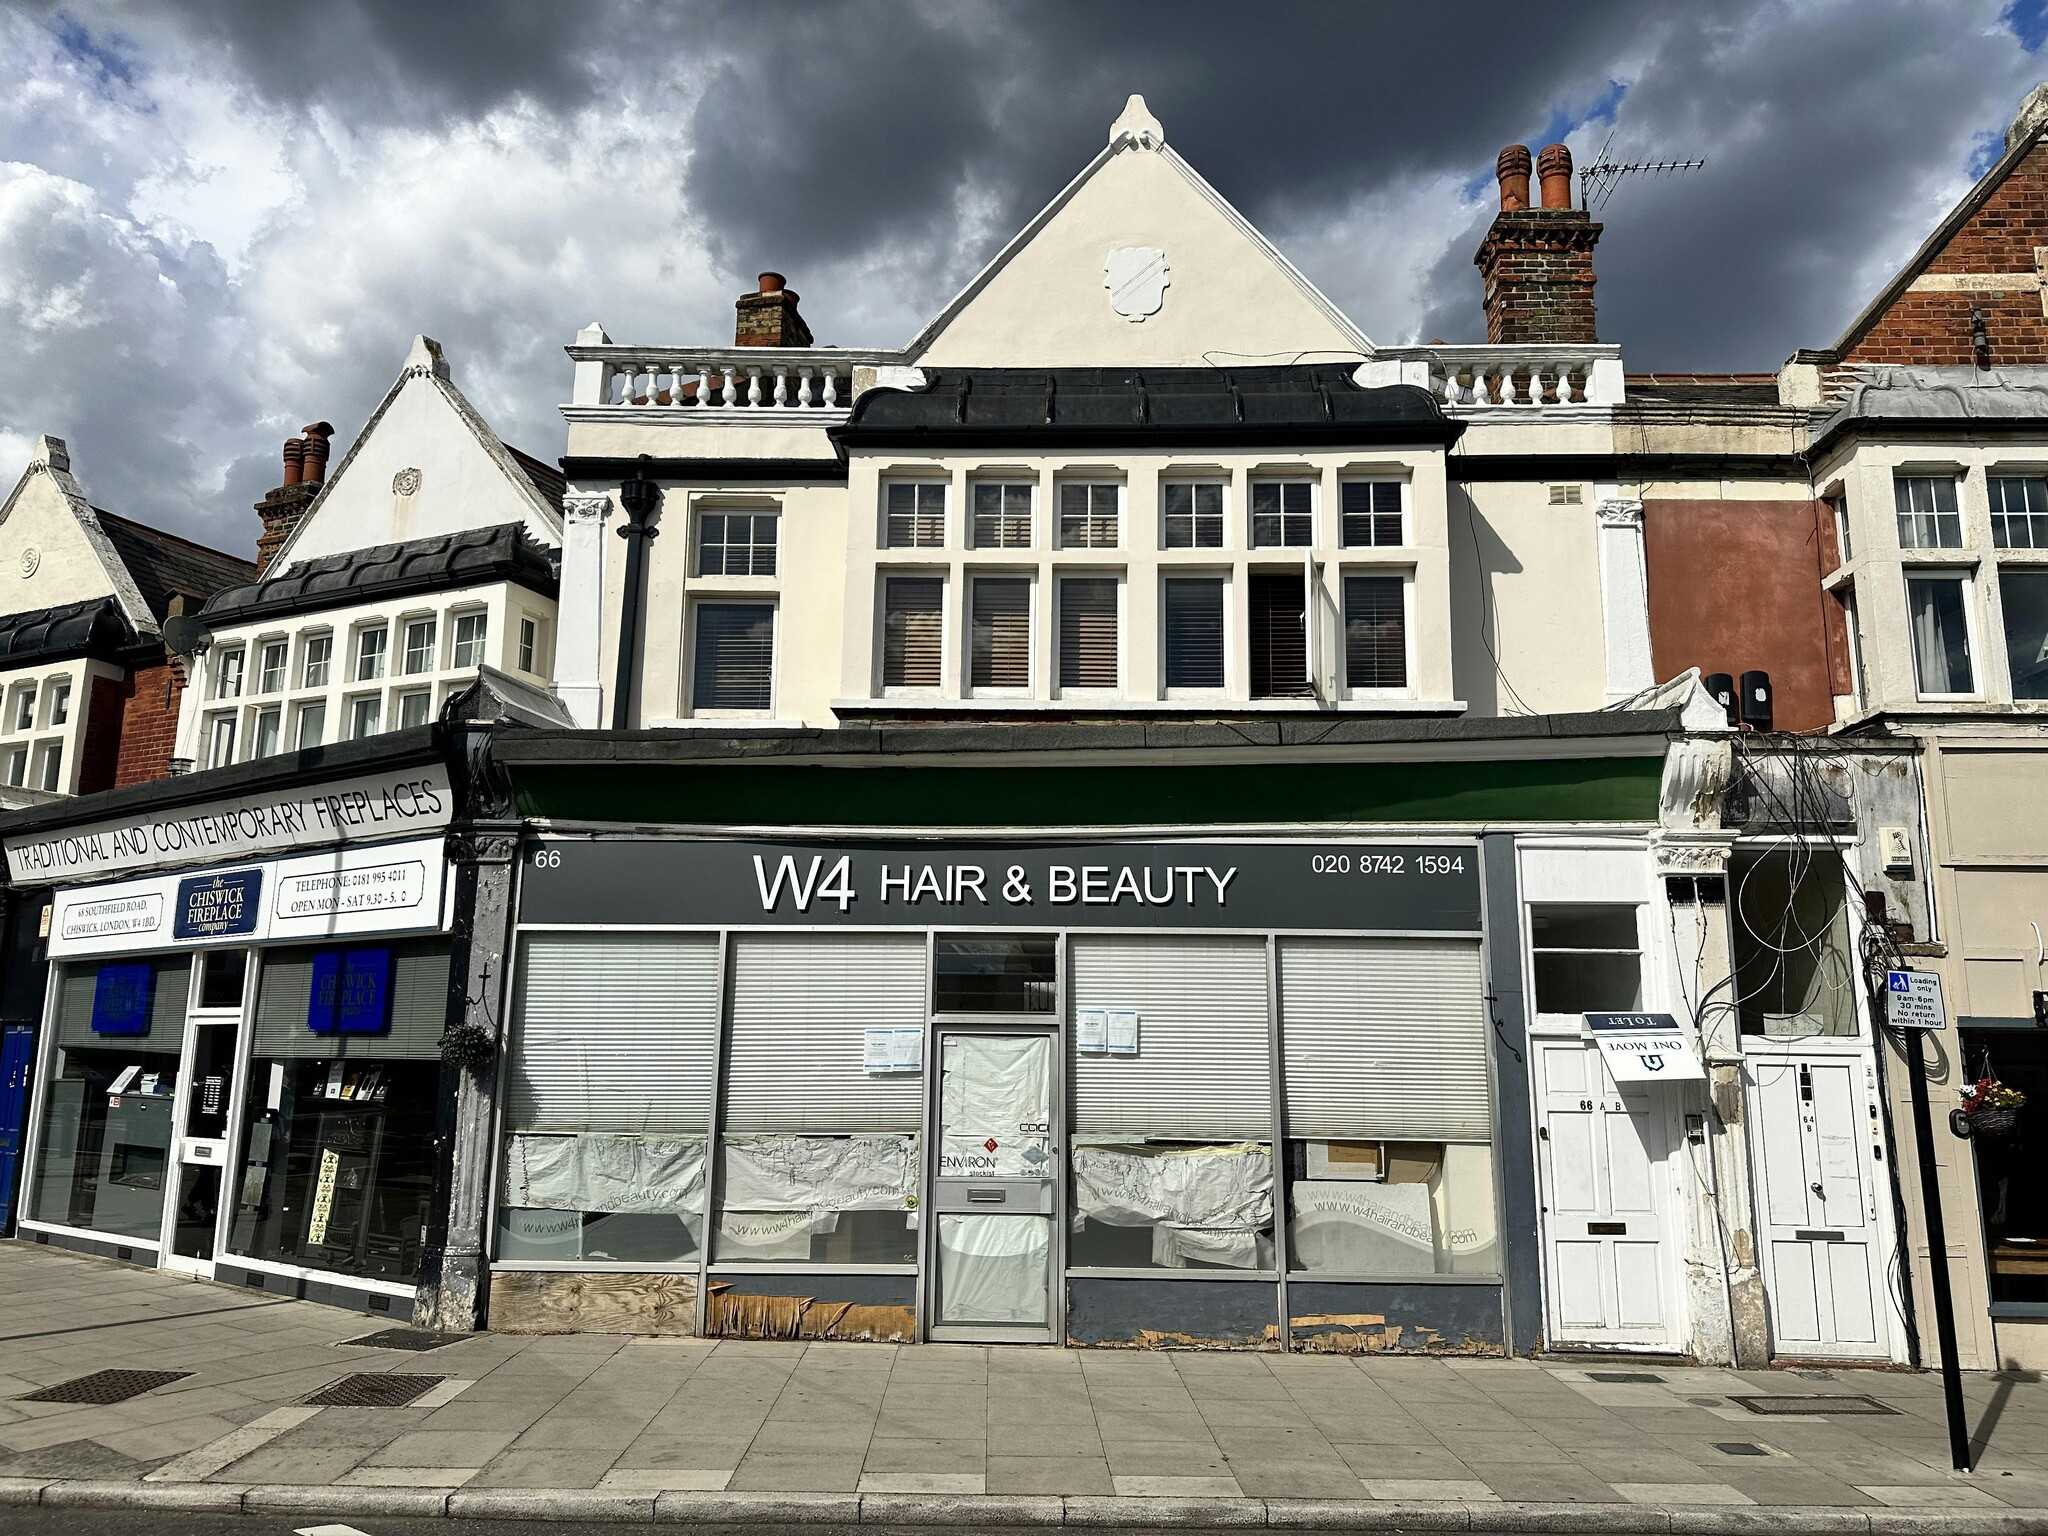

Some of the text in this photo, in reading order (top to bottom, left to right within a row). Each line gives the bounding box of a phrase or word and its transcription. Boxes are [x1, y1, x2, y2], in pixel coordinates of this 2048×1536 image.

[14, 779, 442, 871] TRADITIONAL AND CONTEMPORARY FIREPLACES
[534, 850, 561, 869] 66
[1311, 854, 1464, 875] 020 8742 1594
[212, 875, 224, 889] the
[296, 869, 406, 892] TELEPHONE: 0181 995 4011
[753, 854, 1237, 911] W4 HAIR & BEAUTY
[189, 886, 244, 908] CHISWICK
[291, 900, 315, 913] OPEN
[316, 897, 340, 910] MON
[346, 894, 365, 907] SAT
[366, 893, 383, 906] 9.30
[85, 902, 126, 917] SOUTHFIELD
[126, 900, 148, 912] ROAD,
[187, 903, 243, 924] FIREPLACE
[100, 919, 131, 932] LONDON,
[198, 921, 229, 935] company
[1909, 977, 1937, 986] Loading
[1917, 985, 1932, 993] only
[1911, 1010, 1935, 1018] return
[1608, 1017, 1657, 1026] TO LET
[1924, 1018, 1942, 1026] hour
[1607, 1040, 1682, 1051] ONE MOVE
[1580, 1100, 1621, 1111] 66 A B
